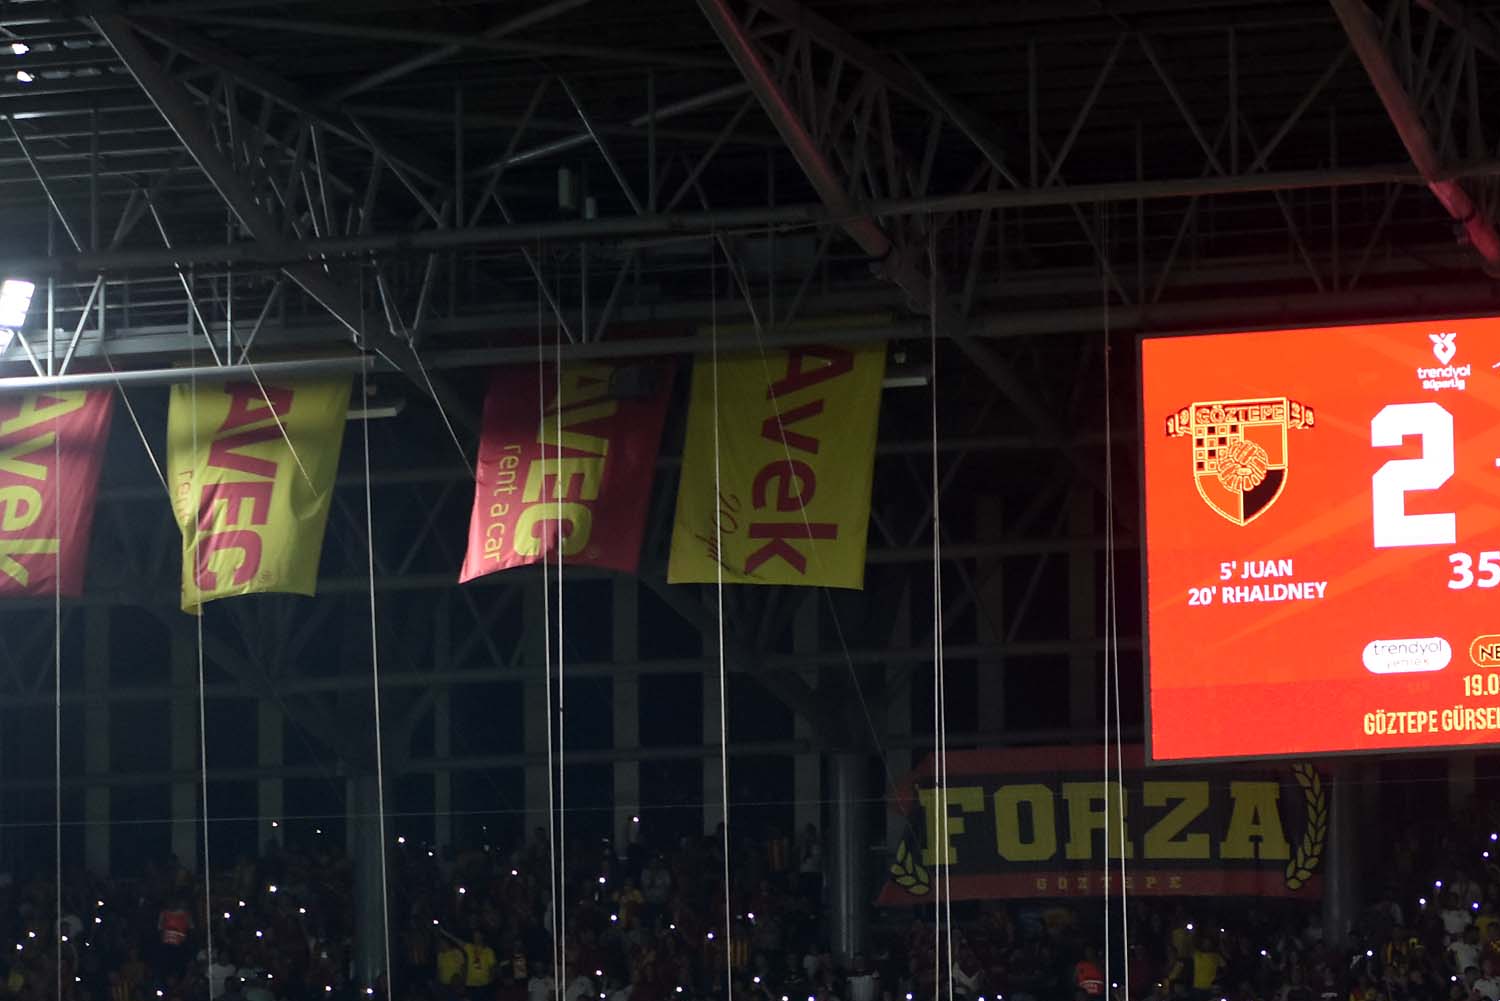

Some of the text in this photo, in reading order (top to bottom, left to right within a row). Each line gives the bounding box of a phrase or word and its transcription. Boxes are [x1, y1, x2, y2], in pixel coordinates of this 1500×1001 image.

[512, 361, 619, 558] AVEC
[744, 344, 855, 575] Avek
[1194, 403, 1287, 424] GÖZTEPE
[0, 390, 88, 588] Avek
[193, 381, 295, 592] AVEC
[482, 443, 524, 561] rent a car
[1371, 401, 1457, 549] 2
[1187, 580, 1328, 606] 20' RHALDNEY
[1219, 558, 1294, 581] 5' JUAN
[1373, 639, 1442, 656] trendyol
[1363, 708, 1439, 735] GÖZTEPE
[917, 779, 1292, 866] FORZA
